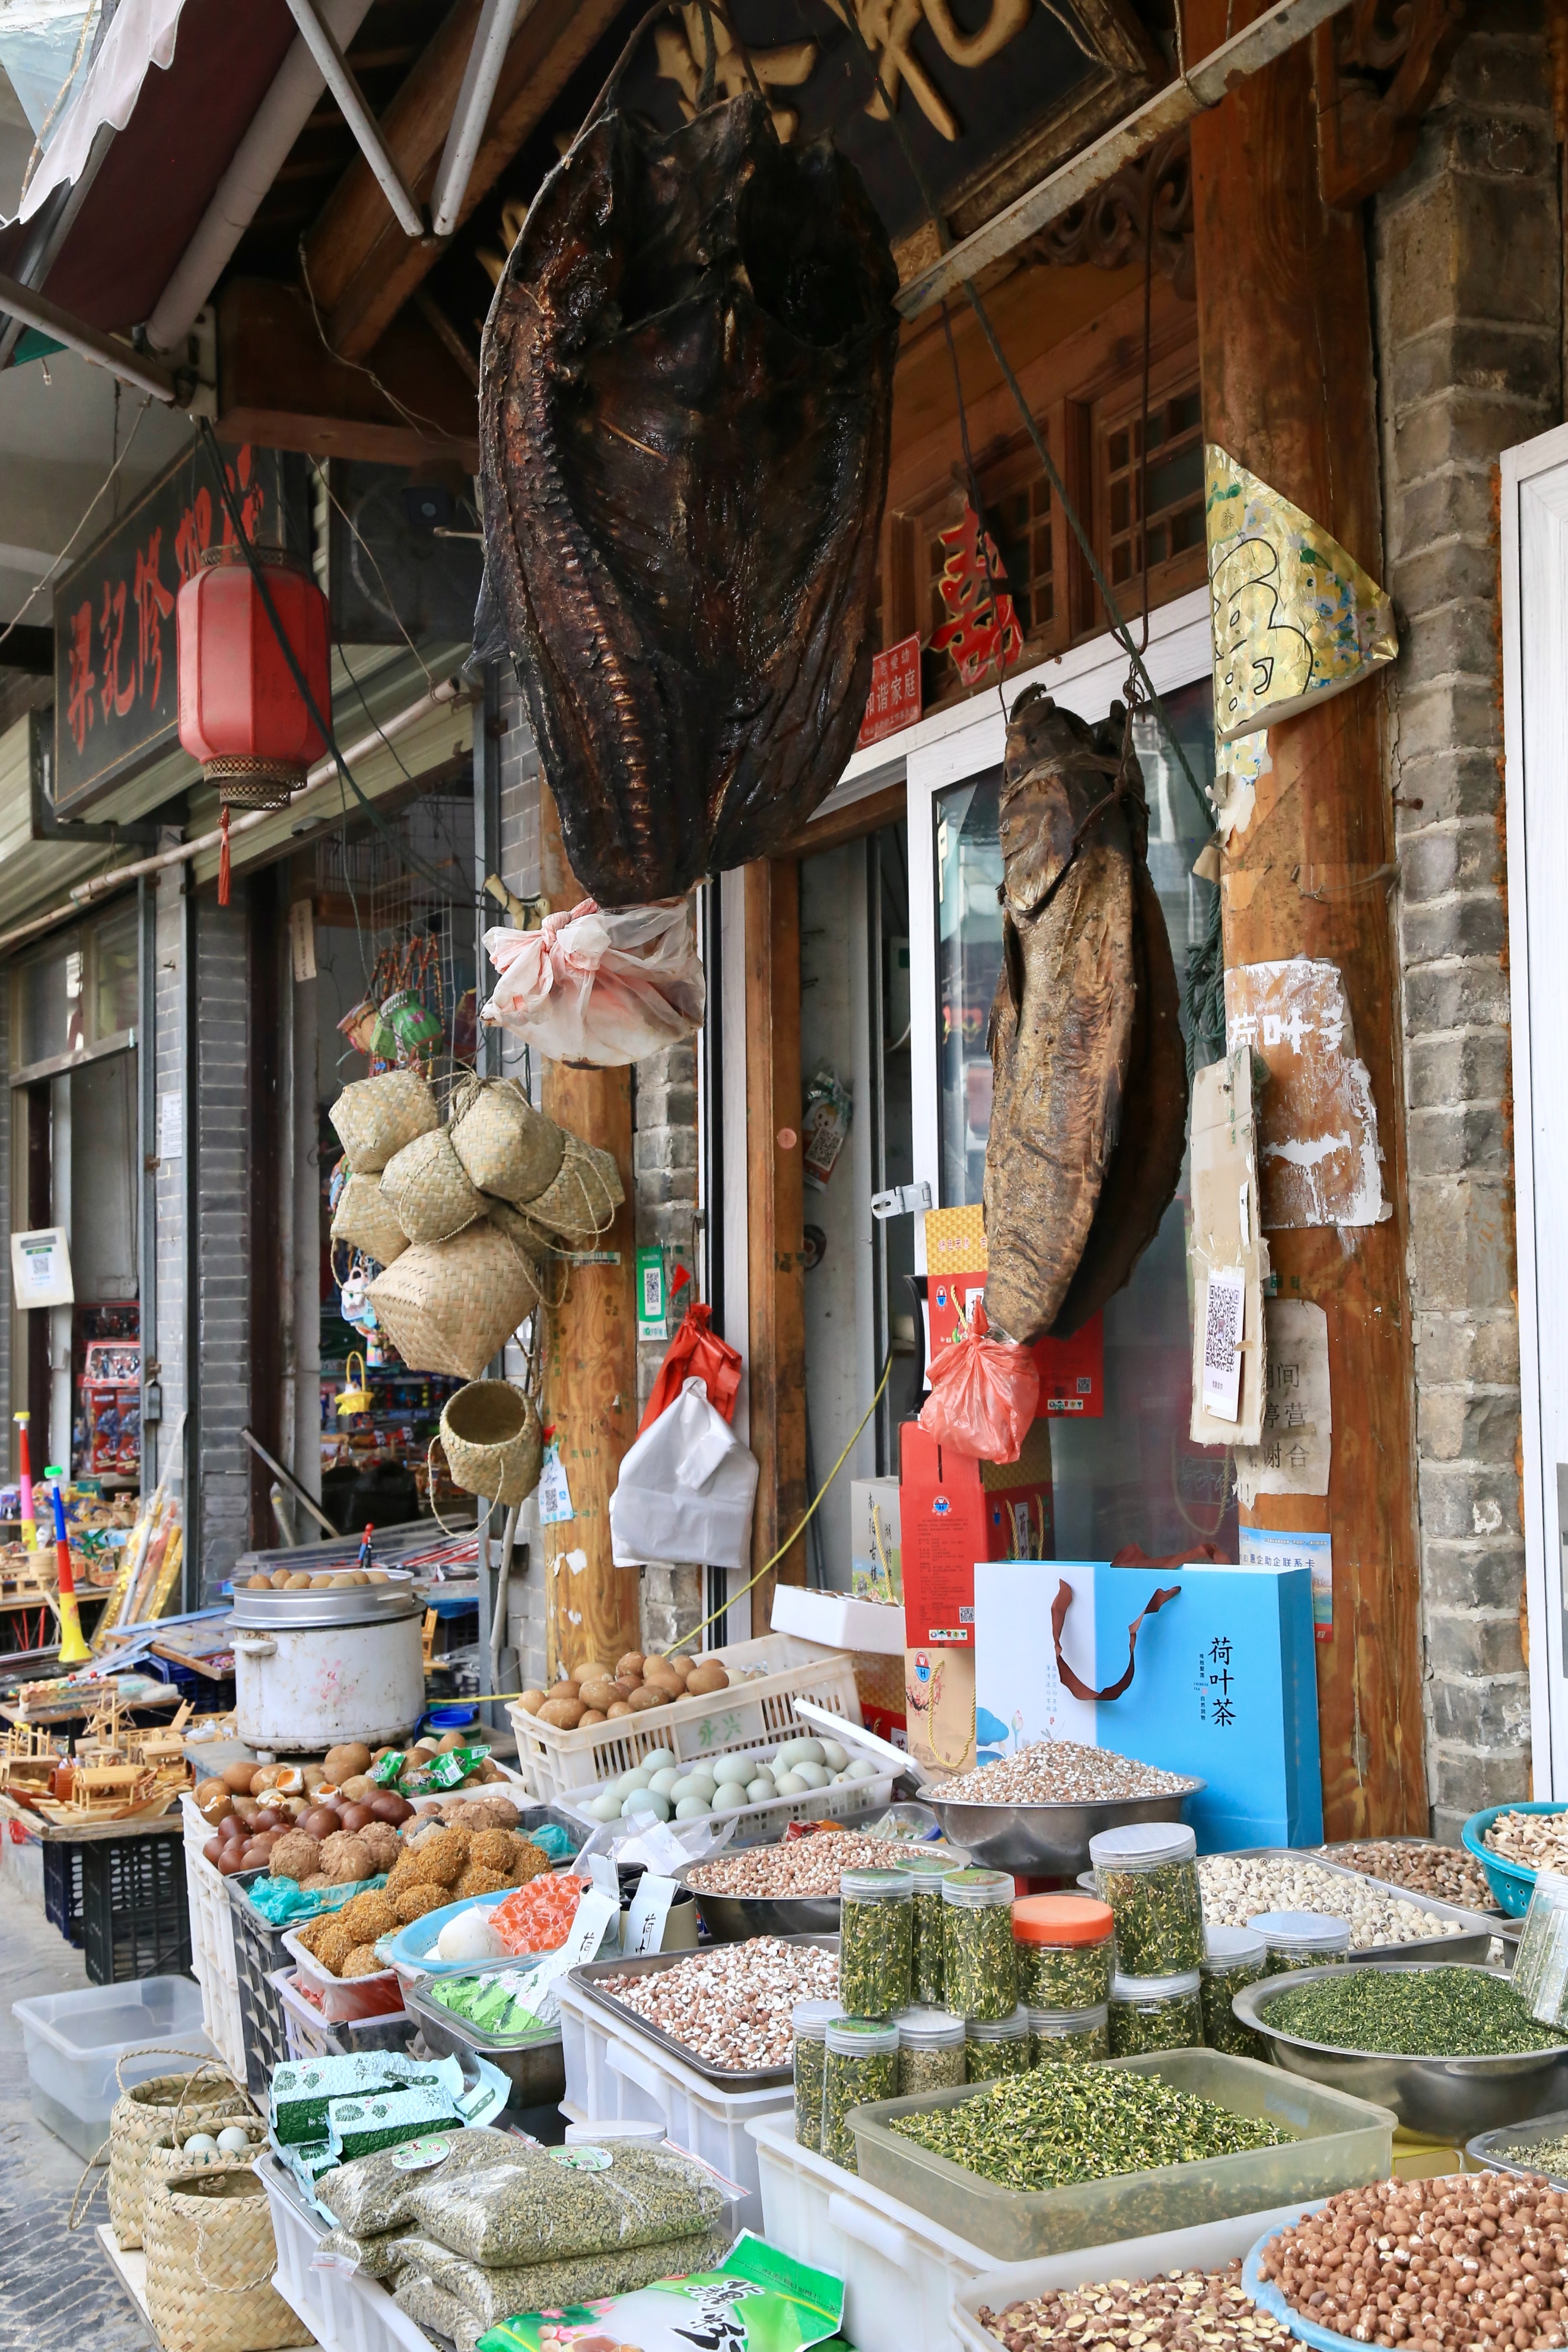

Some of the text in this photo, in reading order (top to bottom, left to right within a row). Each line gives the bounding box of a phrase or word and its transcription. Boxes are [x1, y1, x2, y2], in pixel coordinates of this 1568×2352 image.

[866, 669, 916, 720] 和谐家庭
[872, 648, 910, 681] 老爱幼
[868, 1492, 879, 1585] 南阳古镇
[1208, 1636, 1236, 1727] 荷叶茶
